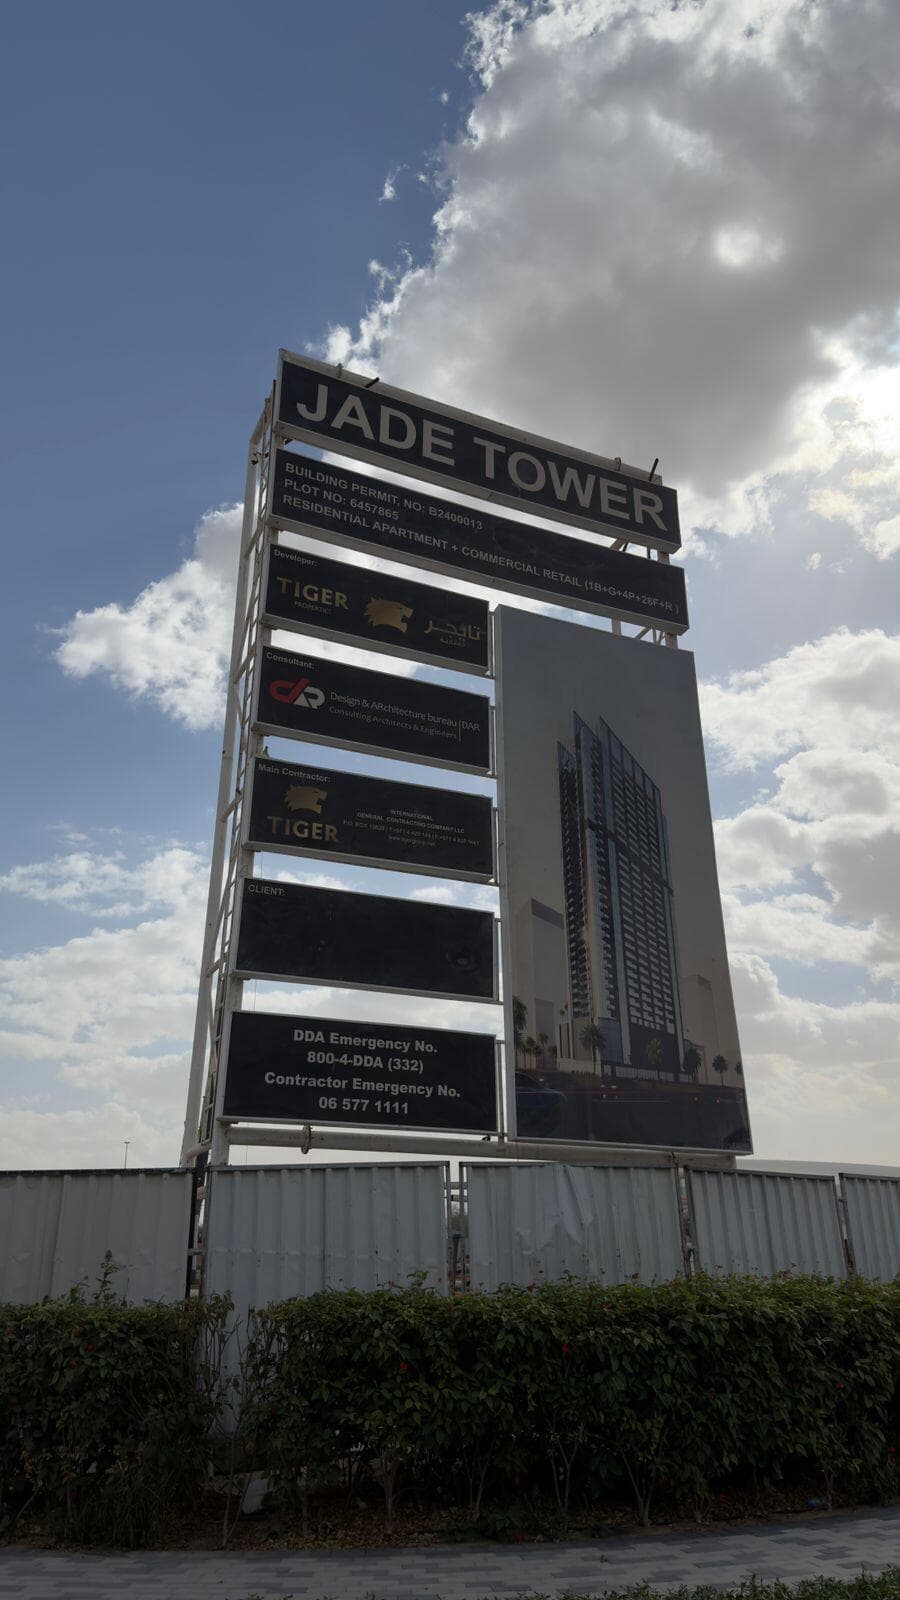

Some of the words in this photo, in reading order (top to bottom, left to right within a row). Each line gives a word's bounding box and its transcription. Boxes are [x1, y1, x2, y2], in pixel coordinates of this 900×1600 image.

[296, 383, 455, 466] JADE
[473, 436, 668, 531] TOWER
[284, 478, 320, 497] PLOT
[323, 489, 346, 505] NO:
[350, 498, 399, 521] 6457865
[285, 462, 348, 489] BUILDING
[403, 499, 425, 512] NO:
[428, 506, 482, 530] B2400013
[282, 494, 370, 528] RESIDENTIAL
[372, 521, 448, 550] APARTMENT
[451, 543, 458, 552] +
[461, 546, 540, 576] COMMERCIAL
[543, 568, 582, 587] RETAIL
[273, 549, 318, 567] Developer:
[276, 576, 349, 610] TIGER
[265, 651, 315, 670] Consultant:
[330, 691, 360, 708] Design
[362, 698, 369, 708] &
[427, 712, 457, 728] bureau
[329, 706, 372, 723] Consulting
[372, 716, 412, 731] Architects
[413, 724, 420, 732] &
[420, 725, 457, 740] Engineers
[258, 763, 280, 775] Main
[281, 767, 331, 783] Contractor:
[357, 811, 385, 822] GENERAL
[386, 817, 426, 829] CONTRACTING
[390, 809, 433, 822] INTERNATIONAL
[267, 815, 339, 843] TIGER
[247, 883, 286, 897] CLIENT:
[293, 1029, 325, 1044] DDA
[329, 1032, 410, 1053] Emergency
[414, 1040, 438, 1054] No.
[307, 1050, 384, 1069] 800-4-DDA
[388, 1057, 424, 1074] (332)
[264, 1071, 348, 1090] Contractor
[352, 1077, 434, 1098] Emergency
[437, 1085, 461, 1098] No.
[318, 1096, 338, 1110] 06
[342, 1097, 370, 1111] 577
[374, 1100, 409, 1115] 1111
